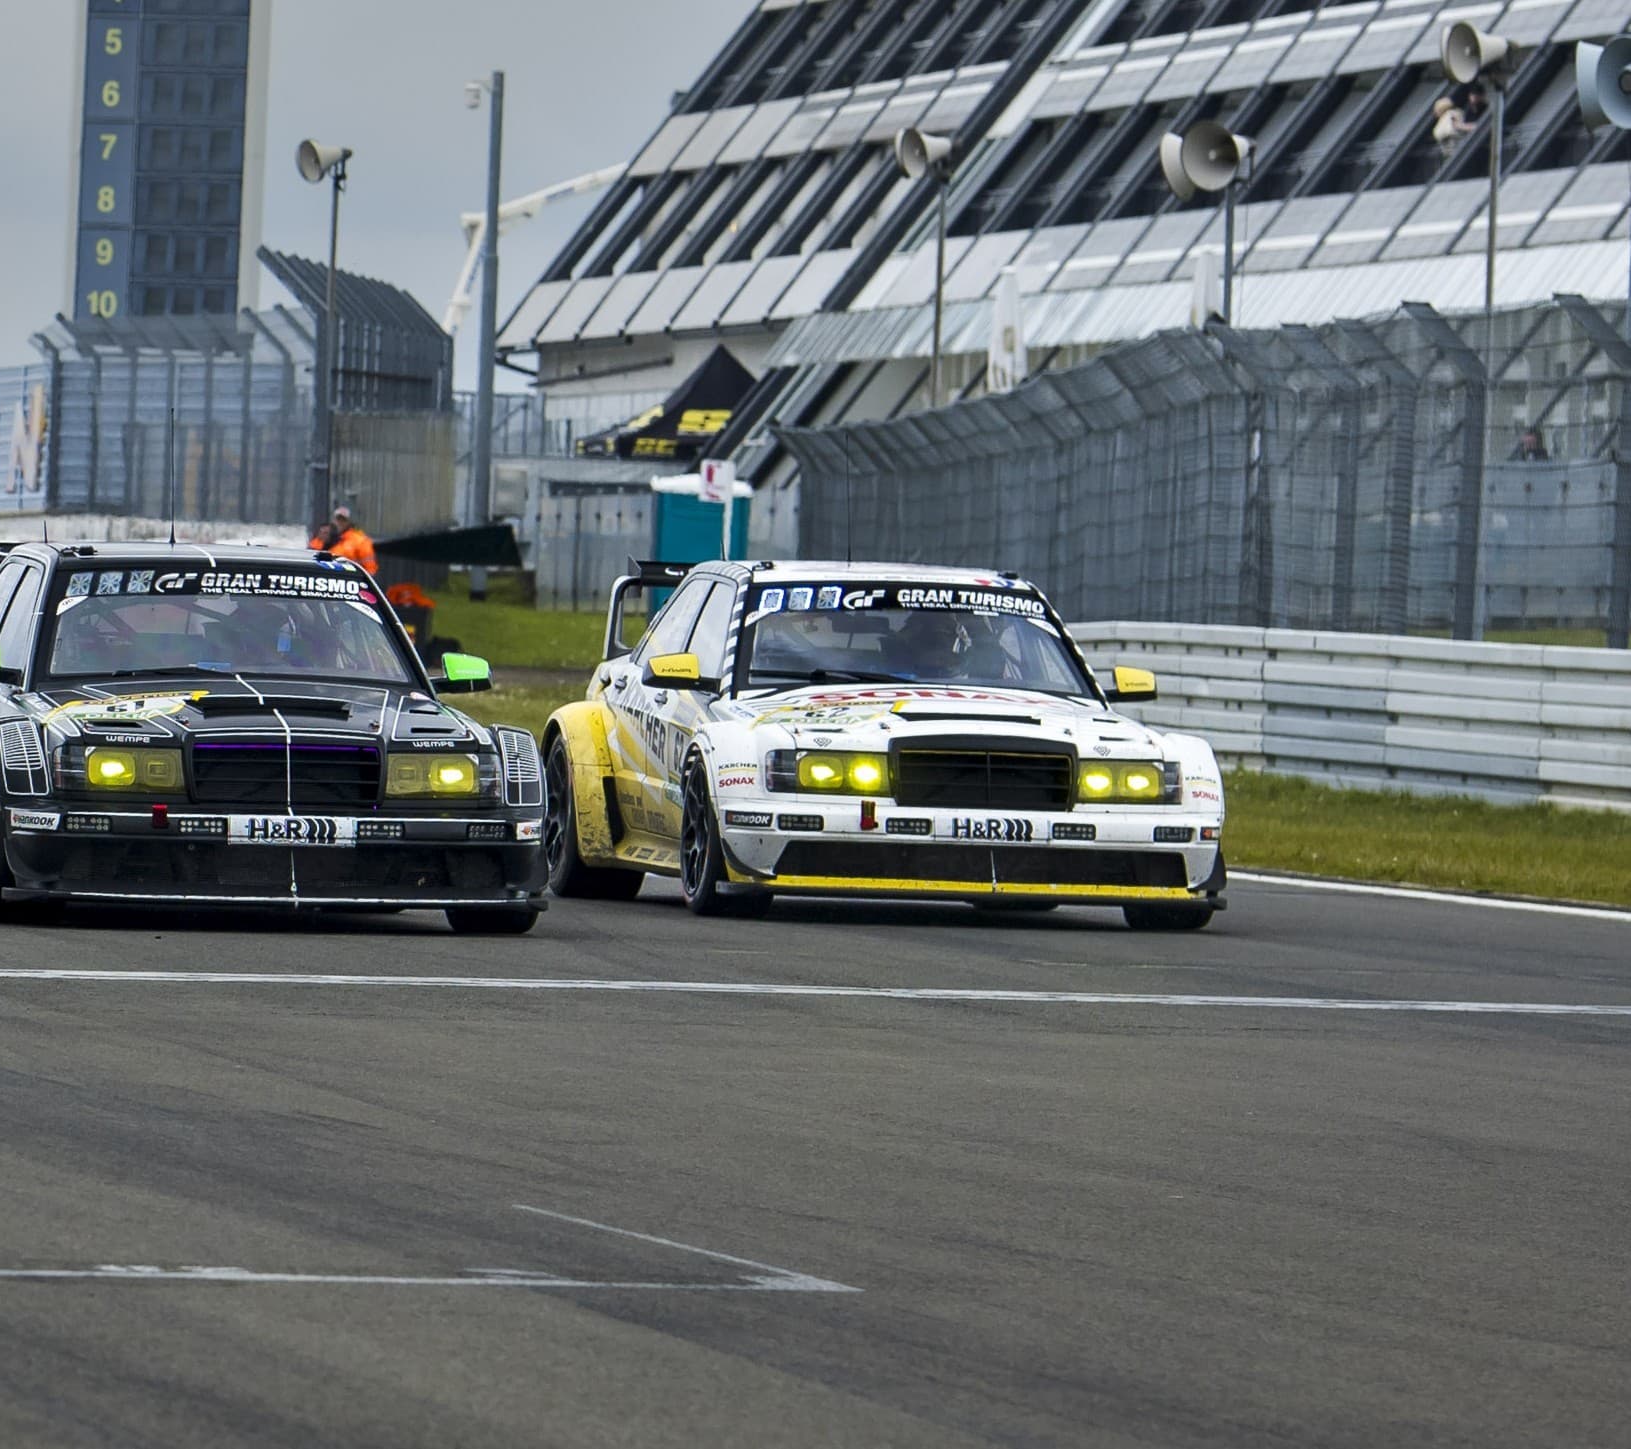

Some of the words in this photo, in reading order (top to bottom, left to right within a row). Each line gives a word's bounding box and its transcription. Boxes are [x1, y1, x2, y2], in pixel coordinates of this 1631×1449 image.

[105, 28, 122, 54] 5
[102, 81, 120, 107] 6
[100, 134, 117, 159] 7
[97, 186, 115, 212] 8
[96, 238, 113, 265] 9
[87, 290, 117, 318] 10
[201, 573, 262, 588] GRAN
[268, 574, 360, 594] TURISMO
[254, 588, 298, 596] DRIVING
[300, 591, 360, 601] SIMULATOR
[897, 589, 953, 603] GRAN
[958, 591, 1045, 614] TURISMO
[105, 735, 151, 744] WEMPE
[718, 776, 755, 788] SONAX
[248, 818, 303, 840] H&R
[952, 817, 1002, 839] H&R
